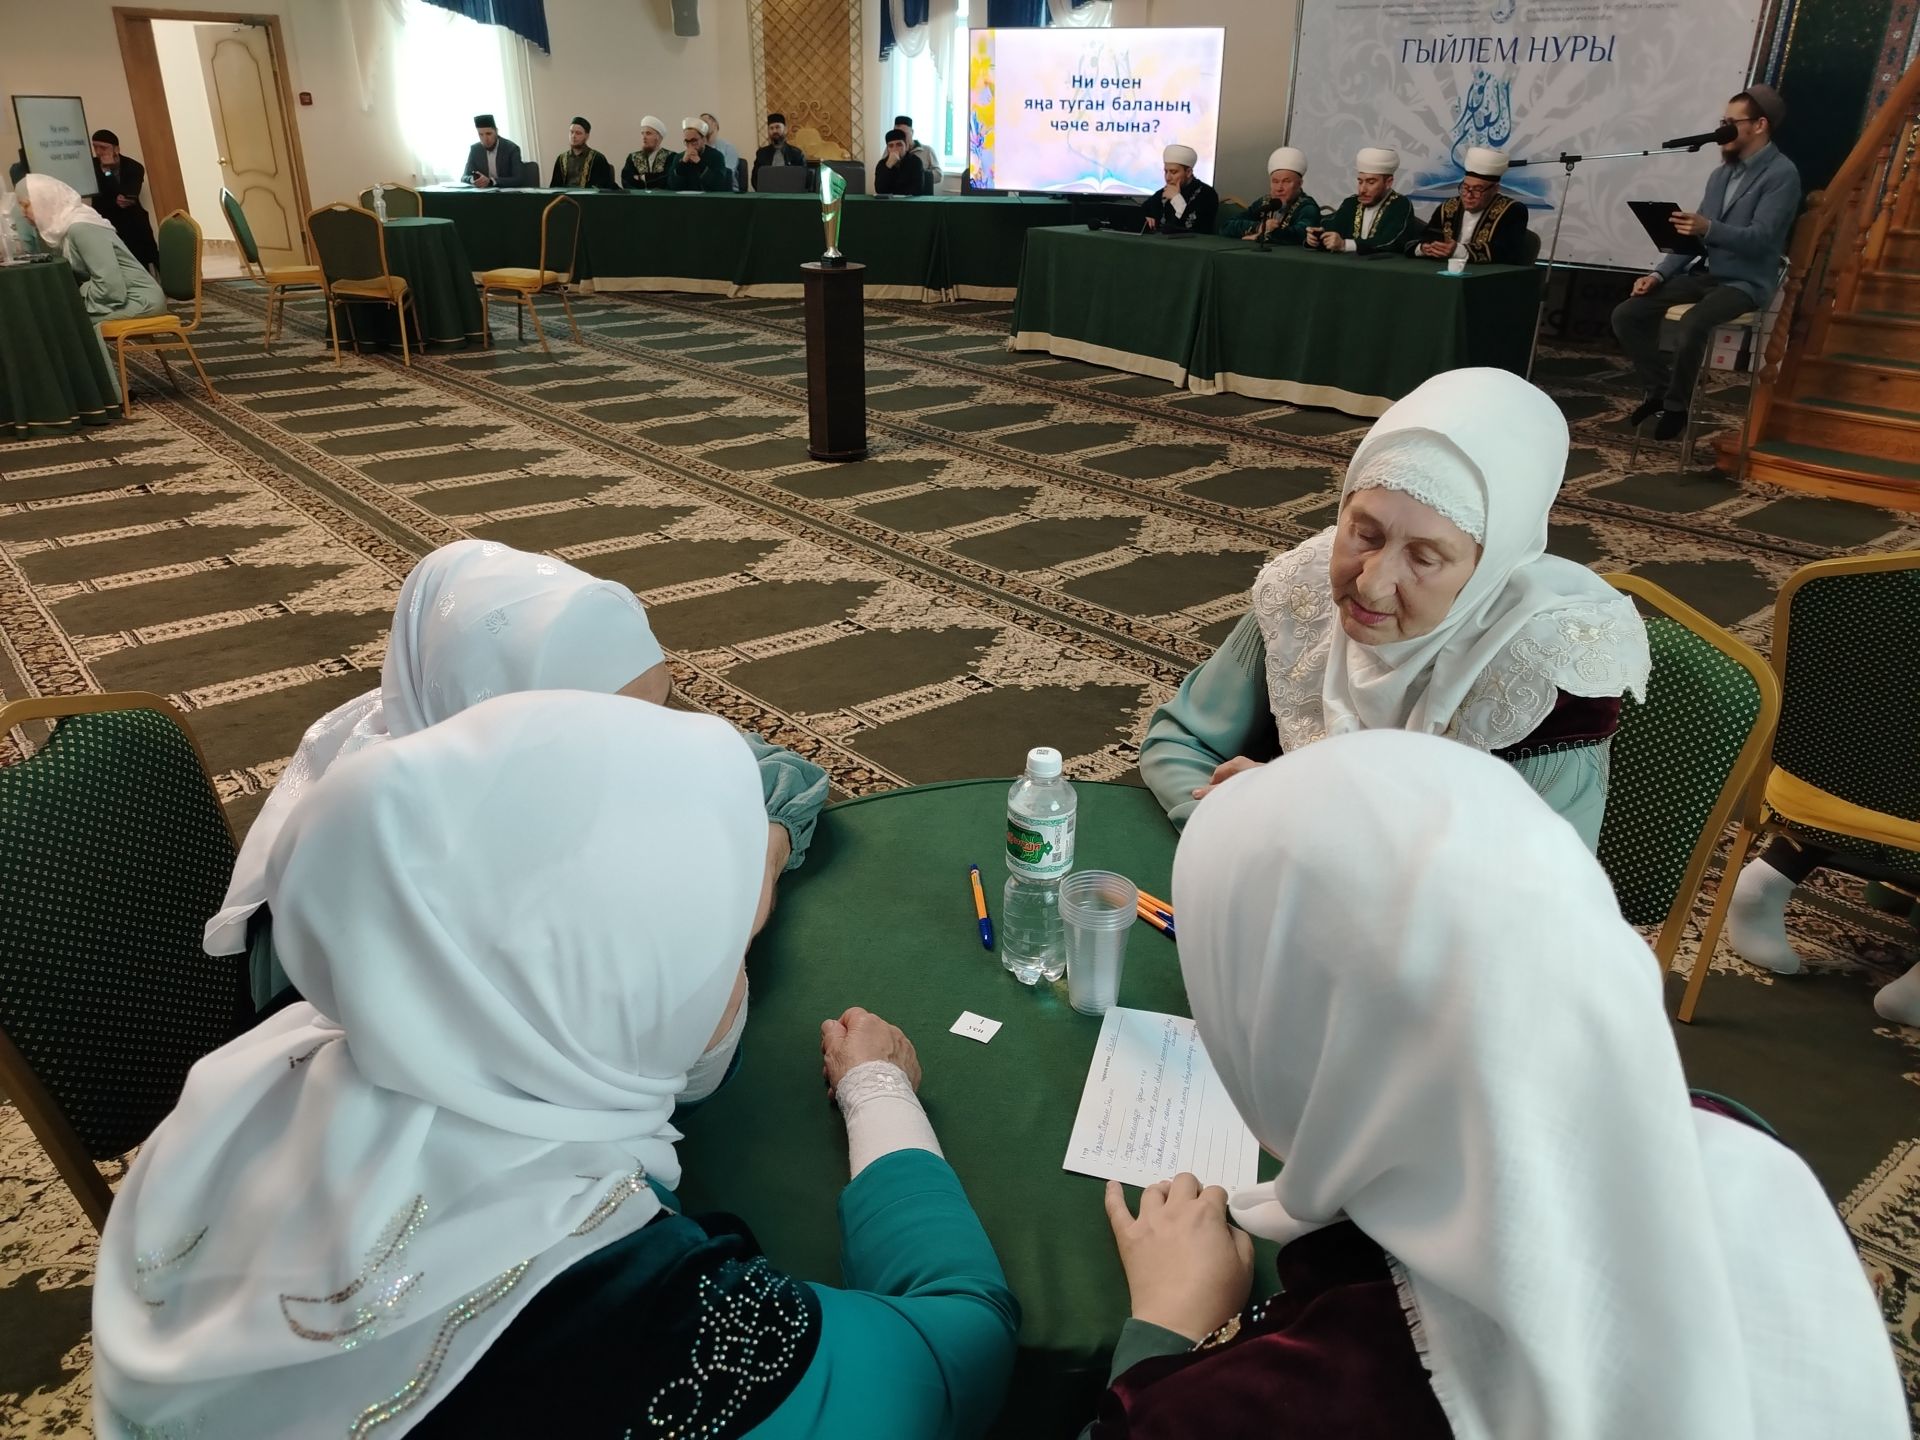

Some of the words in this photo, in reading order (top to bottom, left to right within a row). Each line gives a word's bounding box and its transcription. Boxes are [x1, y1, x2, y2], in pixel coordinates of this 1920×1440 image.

[1401, 34, 1519, 65] ГЫЙЛЕМ
[1528, 35, 1616, 63] НУРЫ
[1071, 75, 1094, 89] Ни
[1100, 77, 1142, 89] өчен
[1024, 98, 1053, 111] яңа
[1059, 98, 1105, 113] туган
[1112, 96, 1191, 114] баланың
[1050, 120, 1089, 132] чәче
[1095, 119, 1160, 133] алына?
